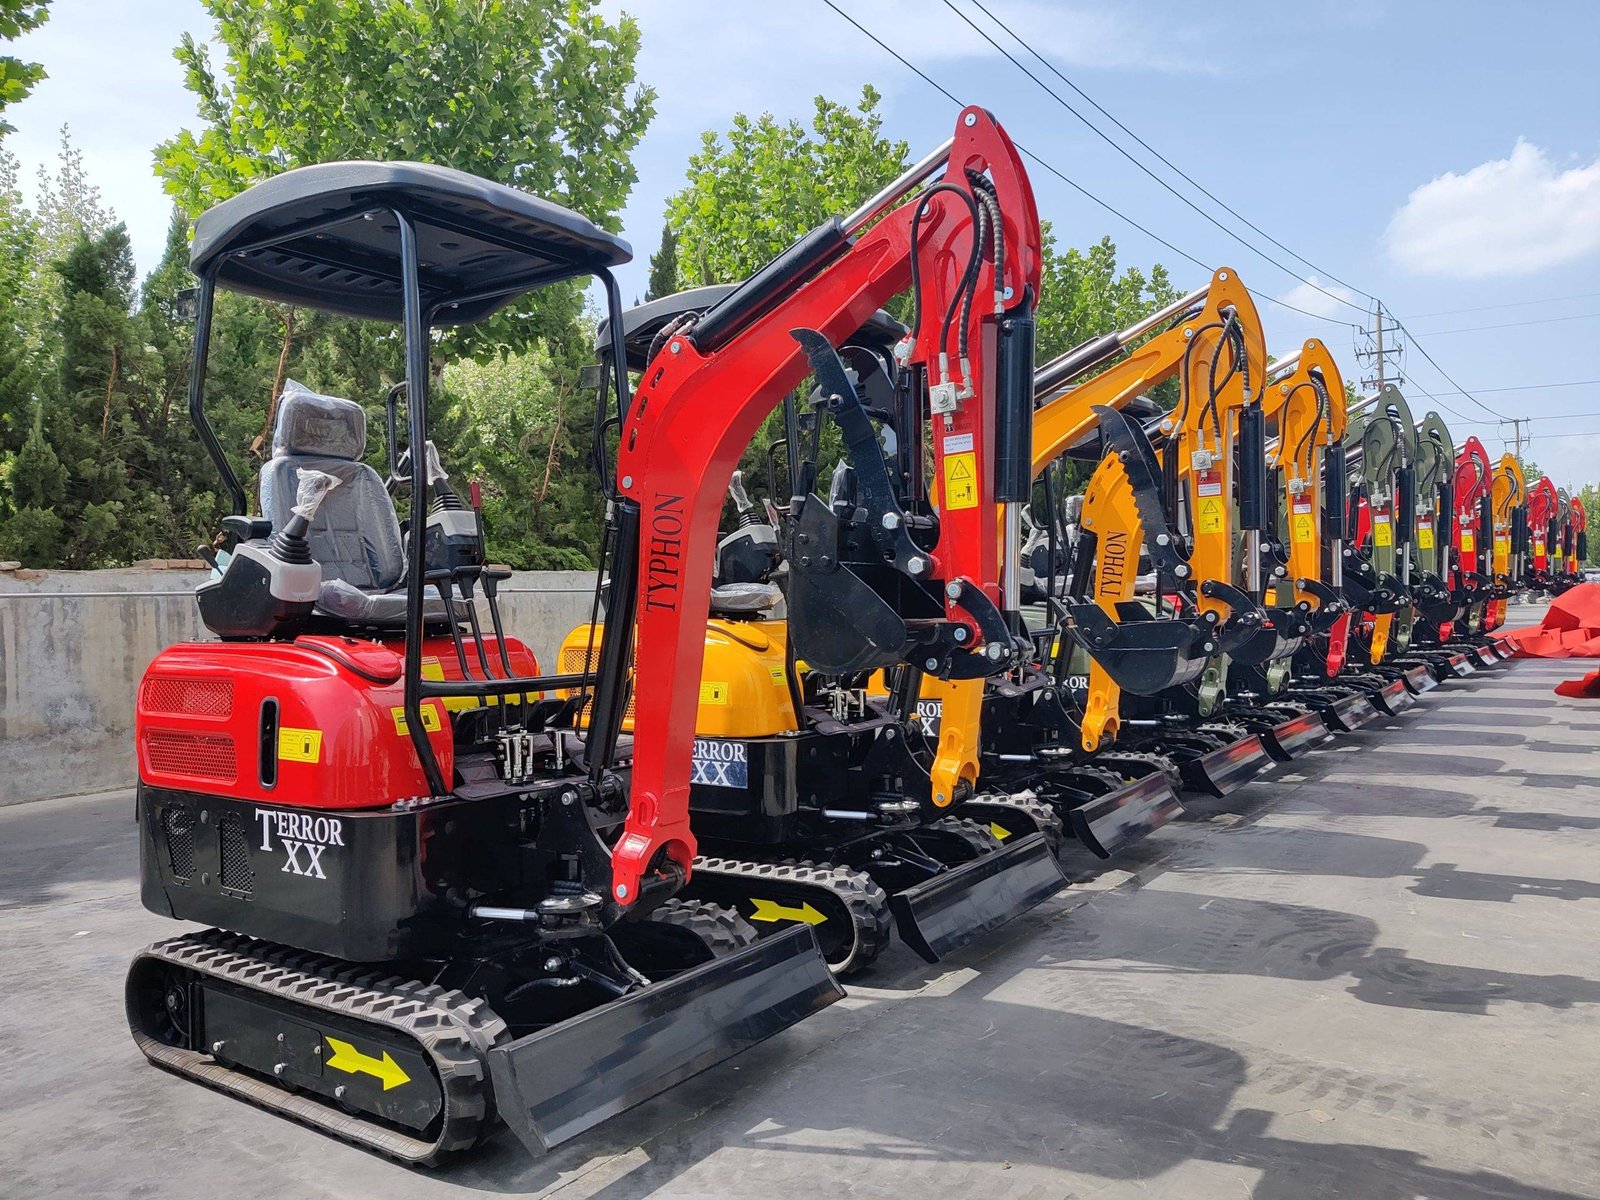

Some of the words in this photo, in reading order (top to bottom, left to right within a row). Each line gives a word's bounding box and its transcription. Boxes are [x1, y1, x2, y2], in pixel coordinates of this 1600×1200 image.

[645, 492, 685, 613] TYPHON
[1100, 530, 1128, 597] TYPHON
[920, 717, 937, 737] X
[692, 740, 748, 763] ERROR
[690, 759, 732, 787] XX
[255, 808, 346, 852] TERROR
[281, 838, 327, 880] XX
